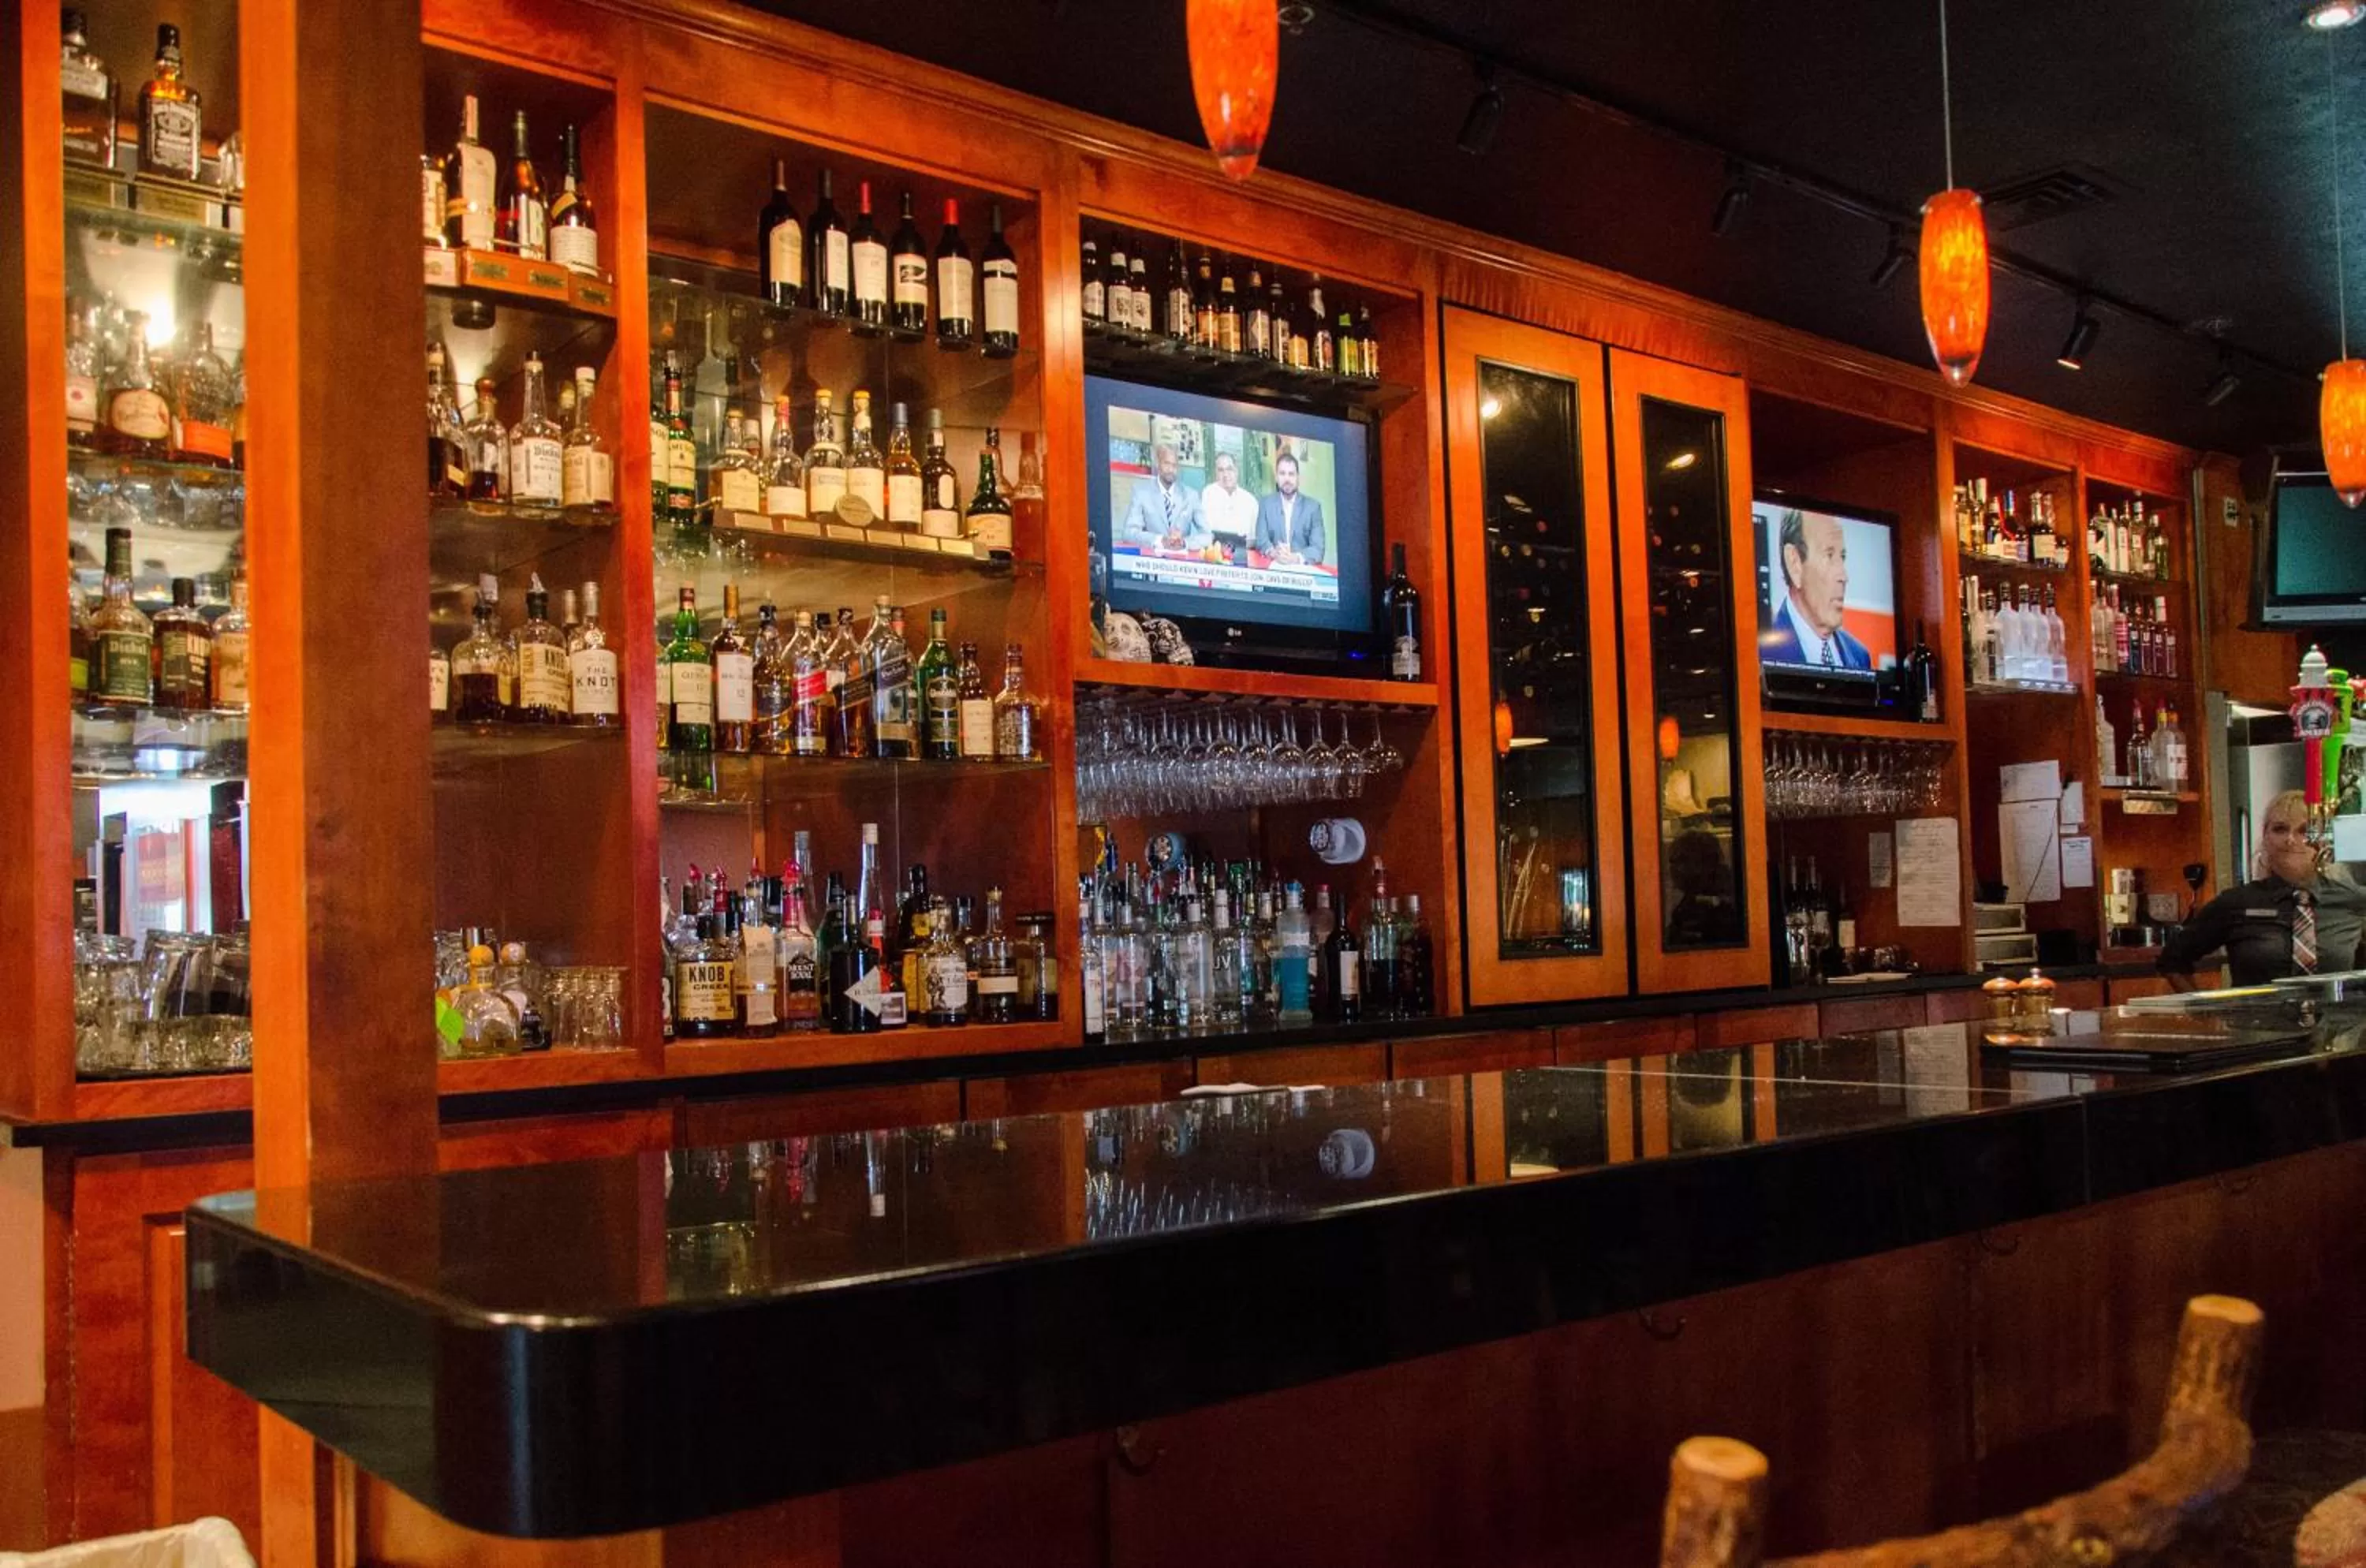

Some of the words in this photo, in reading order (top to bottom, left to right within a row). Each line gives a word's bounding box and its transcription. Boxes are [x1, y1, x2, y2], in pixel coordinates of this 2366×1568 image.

[587, 666, 606, 674] THE
[576, 677, 616, 688] KNOT
[689, 965, 726, 983] KNOB
